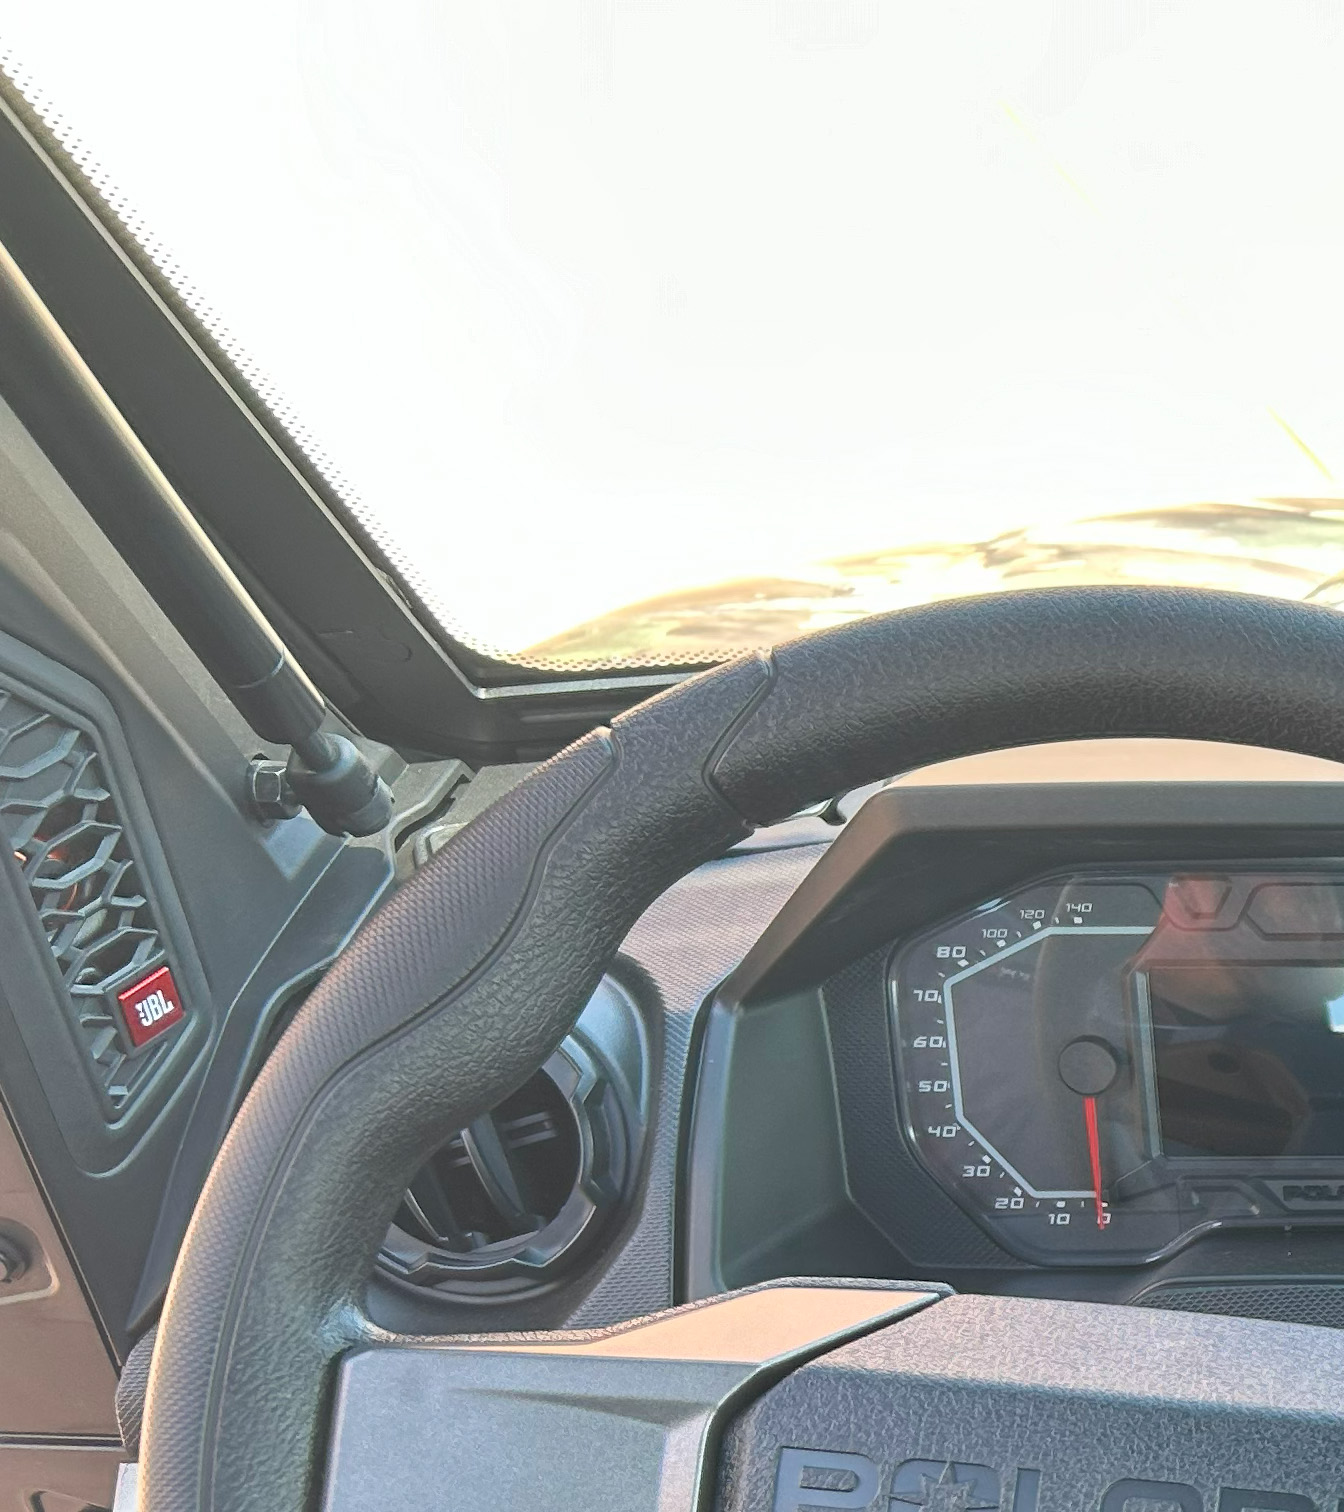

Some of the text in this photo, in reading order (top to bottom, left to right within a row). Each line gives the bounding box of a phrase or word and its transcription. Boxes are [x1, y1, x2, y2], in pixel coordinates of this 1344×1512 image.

[1065, 902, 1092, 913] 140
[1019, 909, 1045, 920] 120
[982, 928, 1008, 939] 100
[936, 946, 966, 958] 80
[913, 990, 939, 1002] 70
[134, 989, 175, 1027] JBL
[914, 1036, 944, 1048] 60
[918, 1080, 948, 1093] 50
[928, 1125, 957, 1138] 40
[962, 1166, 991, 1178] 30
[994, 1198, 1025, 1210] 20
[1048, 1213, 1071, 1226] 10
[1096, 1213, 1111, 1225] 0
